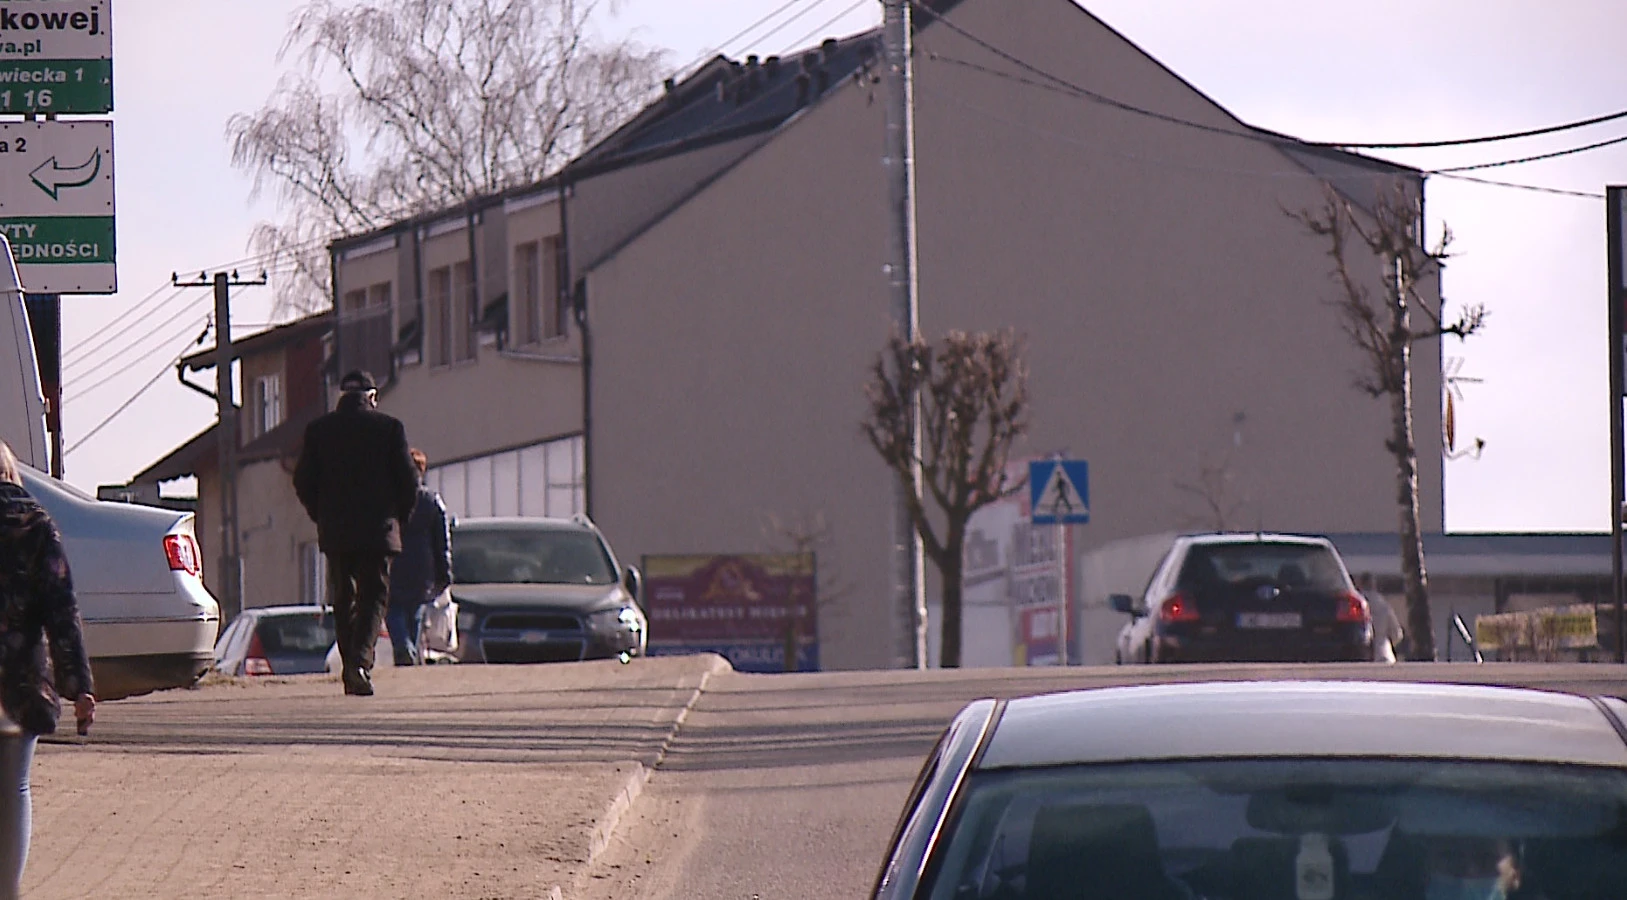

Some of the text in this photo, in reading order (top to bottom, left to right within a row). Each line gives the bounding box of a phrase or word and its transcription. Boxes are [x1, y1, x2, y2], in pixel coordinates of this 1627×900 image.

[0, 6, 98, 35] kowej
[0, 39, 41, 56] a.pl
[75, 67, 83, 81] 1
[24, 89, 52, 107] 16
[15, 137, 26, 152] 2
